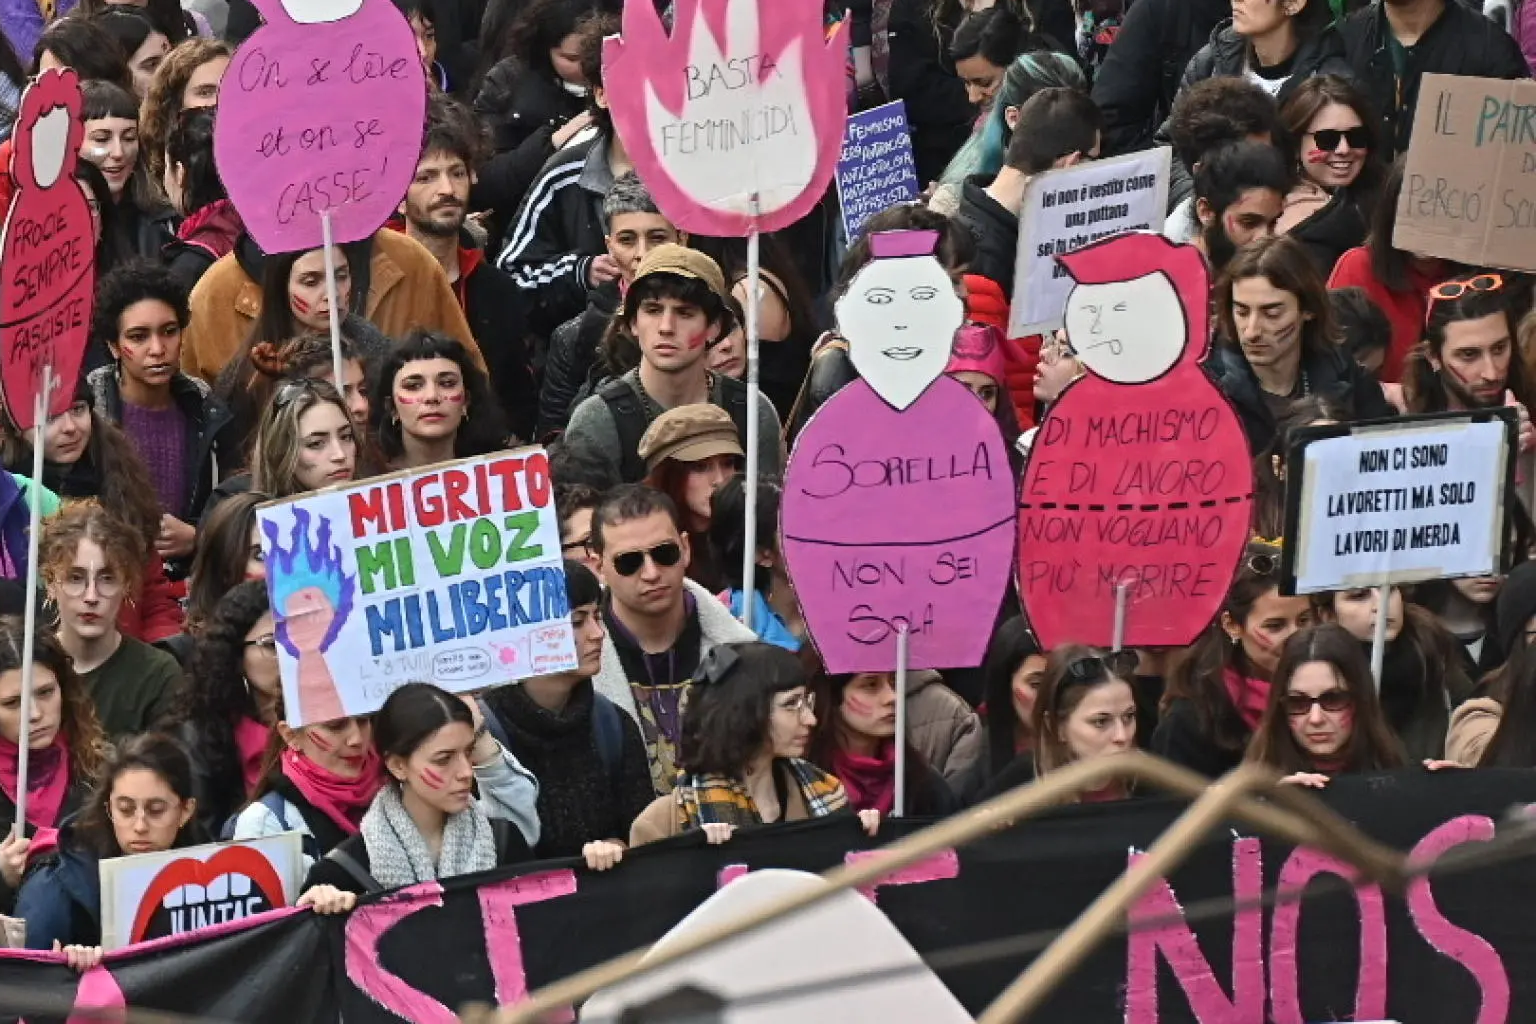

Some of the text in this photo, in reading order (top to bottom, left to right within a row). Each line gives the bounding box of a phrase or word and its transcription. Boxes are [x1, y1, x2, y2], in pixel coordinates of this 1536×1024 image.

[238, 47, 288, 92] On
[683, 52, 783, 101] BASTA
[1434, 90, 1457, 135] IL
[256, 119, 385, 158] et on se
[1042, 189, 1057, 209] lei
[1057, 188, 1079, 205] non
[1125, 174, 1156, 192] come
[12, 204, 68, 258] FROCIE
[1065, 202, 1129, 228] una puttana
[1037, 238, 1055, 257] sei
[12, 236, 82, 309] SEMPRE
[10, 297, 84, 365] FASCISTE
[1044, 407, 1220, 448] DI MACHISMO
[801, 441, 993, 499] SORELLA
[1030, 459, 1226, 496] E DI LAVORO
[1359, 443, 1448, 474] NON CI SONO
[347, 453, 551, 539] MI GRITO
[1327, 481, 1476, 518] LAVORETTI MA SOLO
[355, 510, 544, 595] MI VOZ
[1022, 514, 1223, 549] NON VOGLIAMO
[1334, 522, 1461, 557] LAVORI DI MERDA
[832, 551, 978, 593] NON SEI
[1095, 561, 1218, 600] MORIRE
[364, 594, 426, 657] MI
[846, 602, 935, 646] SOLA
